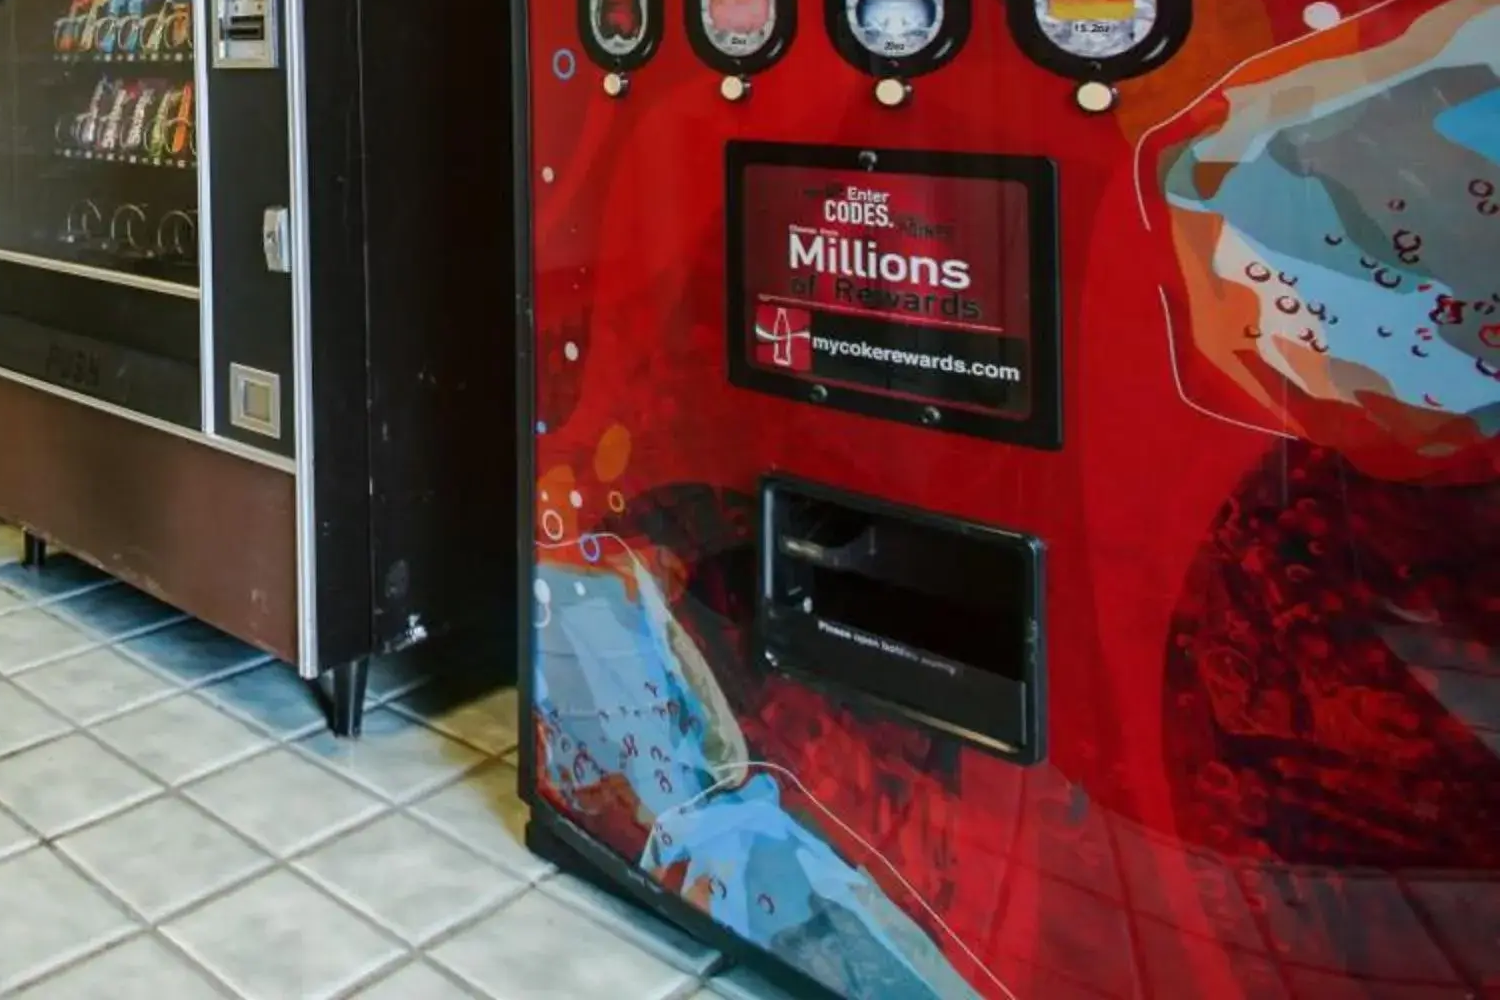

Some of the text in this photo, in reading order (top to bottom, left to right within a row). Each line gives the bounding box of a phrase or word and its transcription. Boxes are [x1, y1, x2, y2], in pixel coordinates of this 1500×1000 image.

[846, 185, 891, 203] Enter
[788, 232, 972, 290] Millions
[791, 274, 982, 320] of Rewards
[811, 333, 1021, 382] mycokerewards.com
